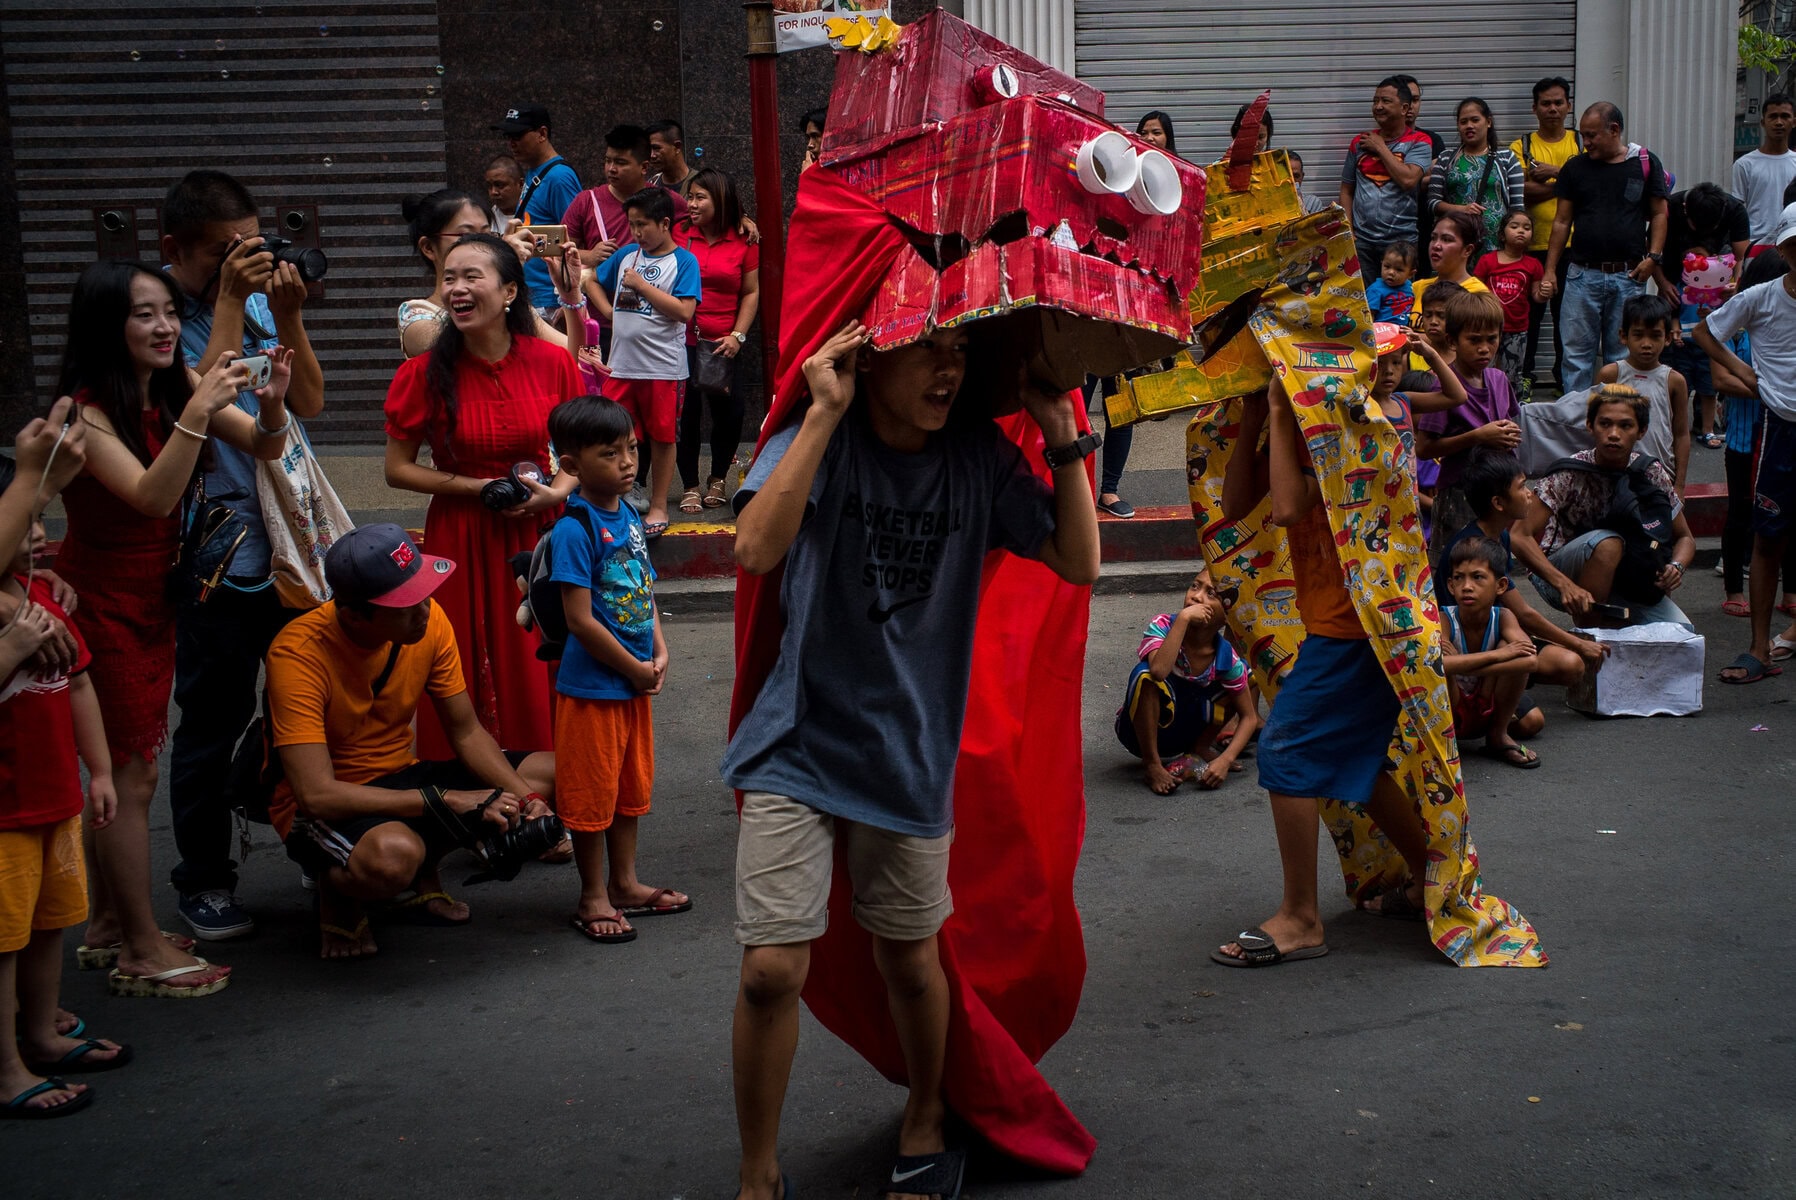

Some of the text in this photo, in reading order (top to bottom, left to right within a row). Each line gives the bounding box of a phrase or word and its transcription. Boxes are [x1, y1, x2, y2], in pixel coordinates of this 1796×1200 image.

[778, 16, 825, 31] FOR INQU
[866, 532, 940, 565] NEVER
[862, 563, 933, 593] STOPS
